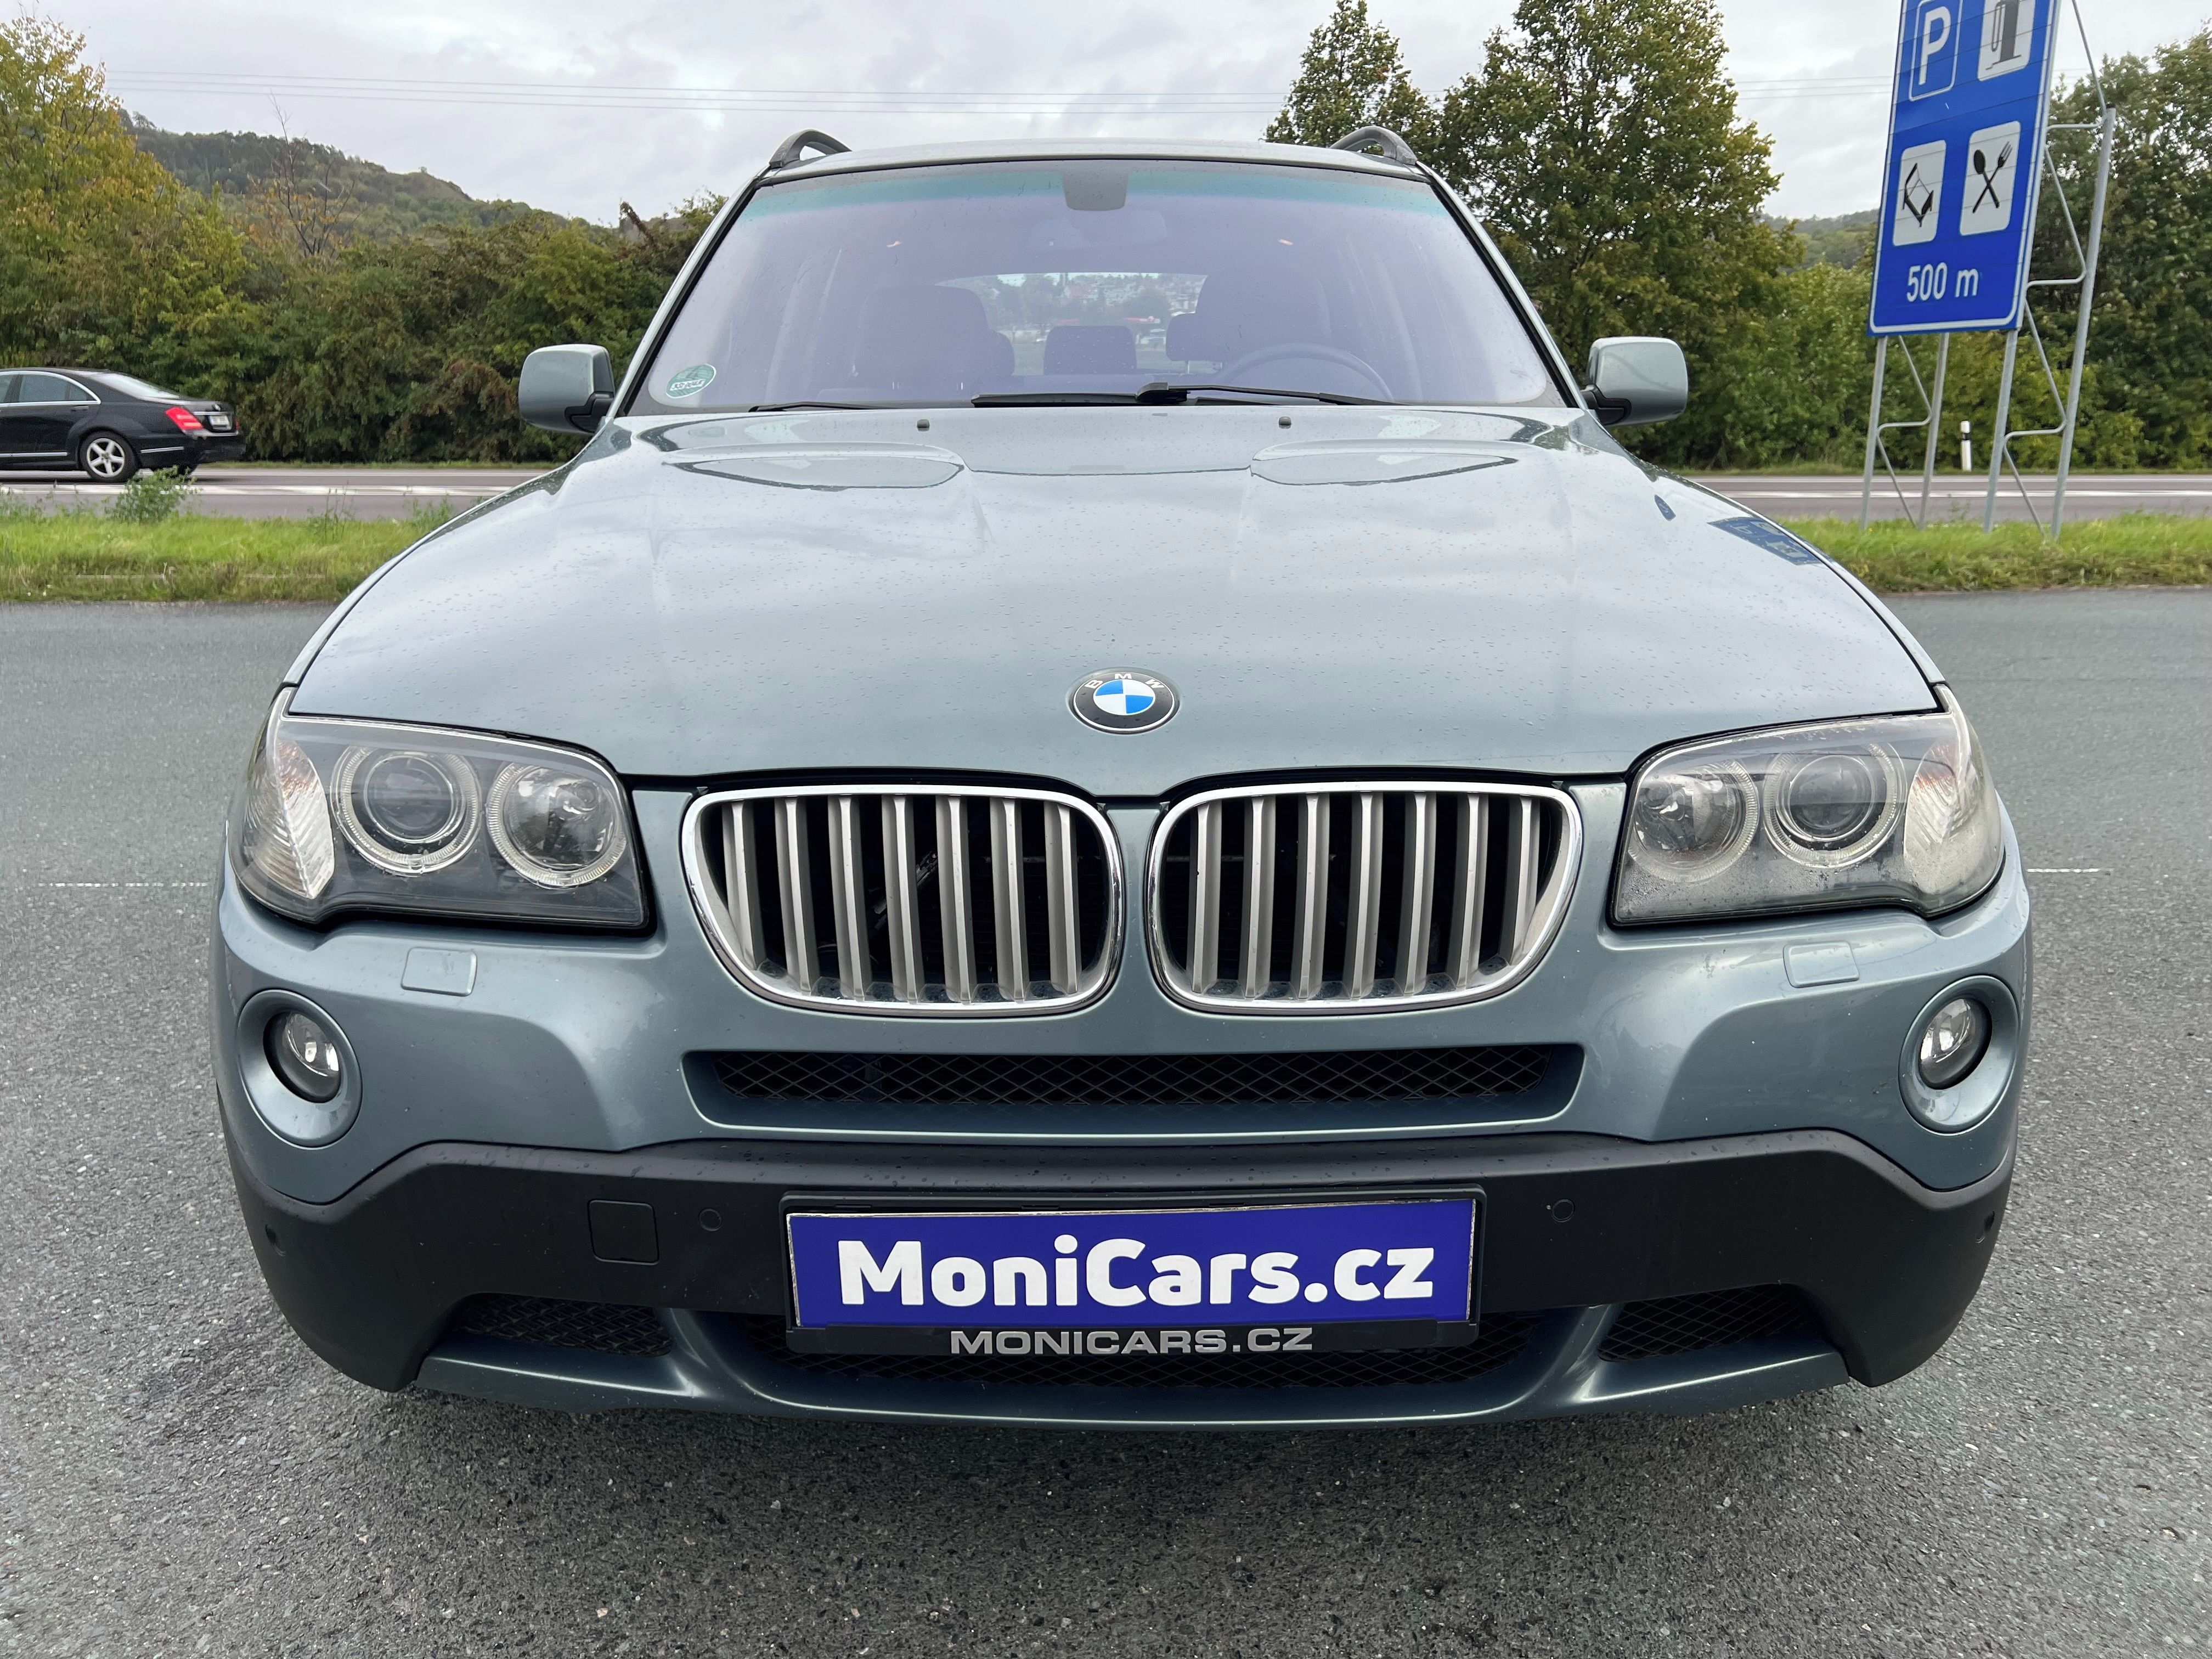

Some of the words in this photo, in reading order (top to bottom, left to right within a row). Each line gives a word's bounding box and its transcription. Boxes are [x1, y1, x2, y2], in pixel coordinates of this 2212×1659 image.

[1918, 5, 1951, 86] P
[1906, 262, 1948, 302] 500
[1955, 266, 1979, 298] m
[1085, 673, 1165, 689] BMW
[838, 1233, 1434, 1307] MoniCars.cz
[950, 1327, 1312, 1355] MONICARS.CZ
